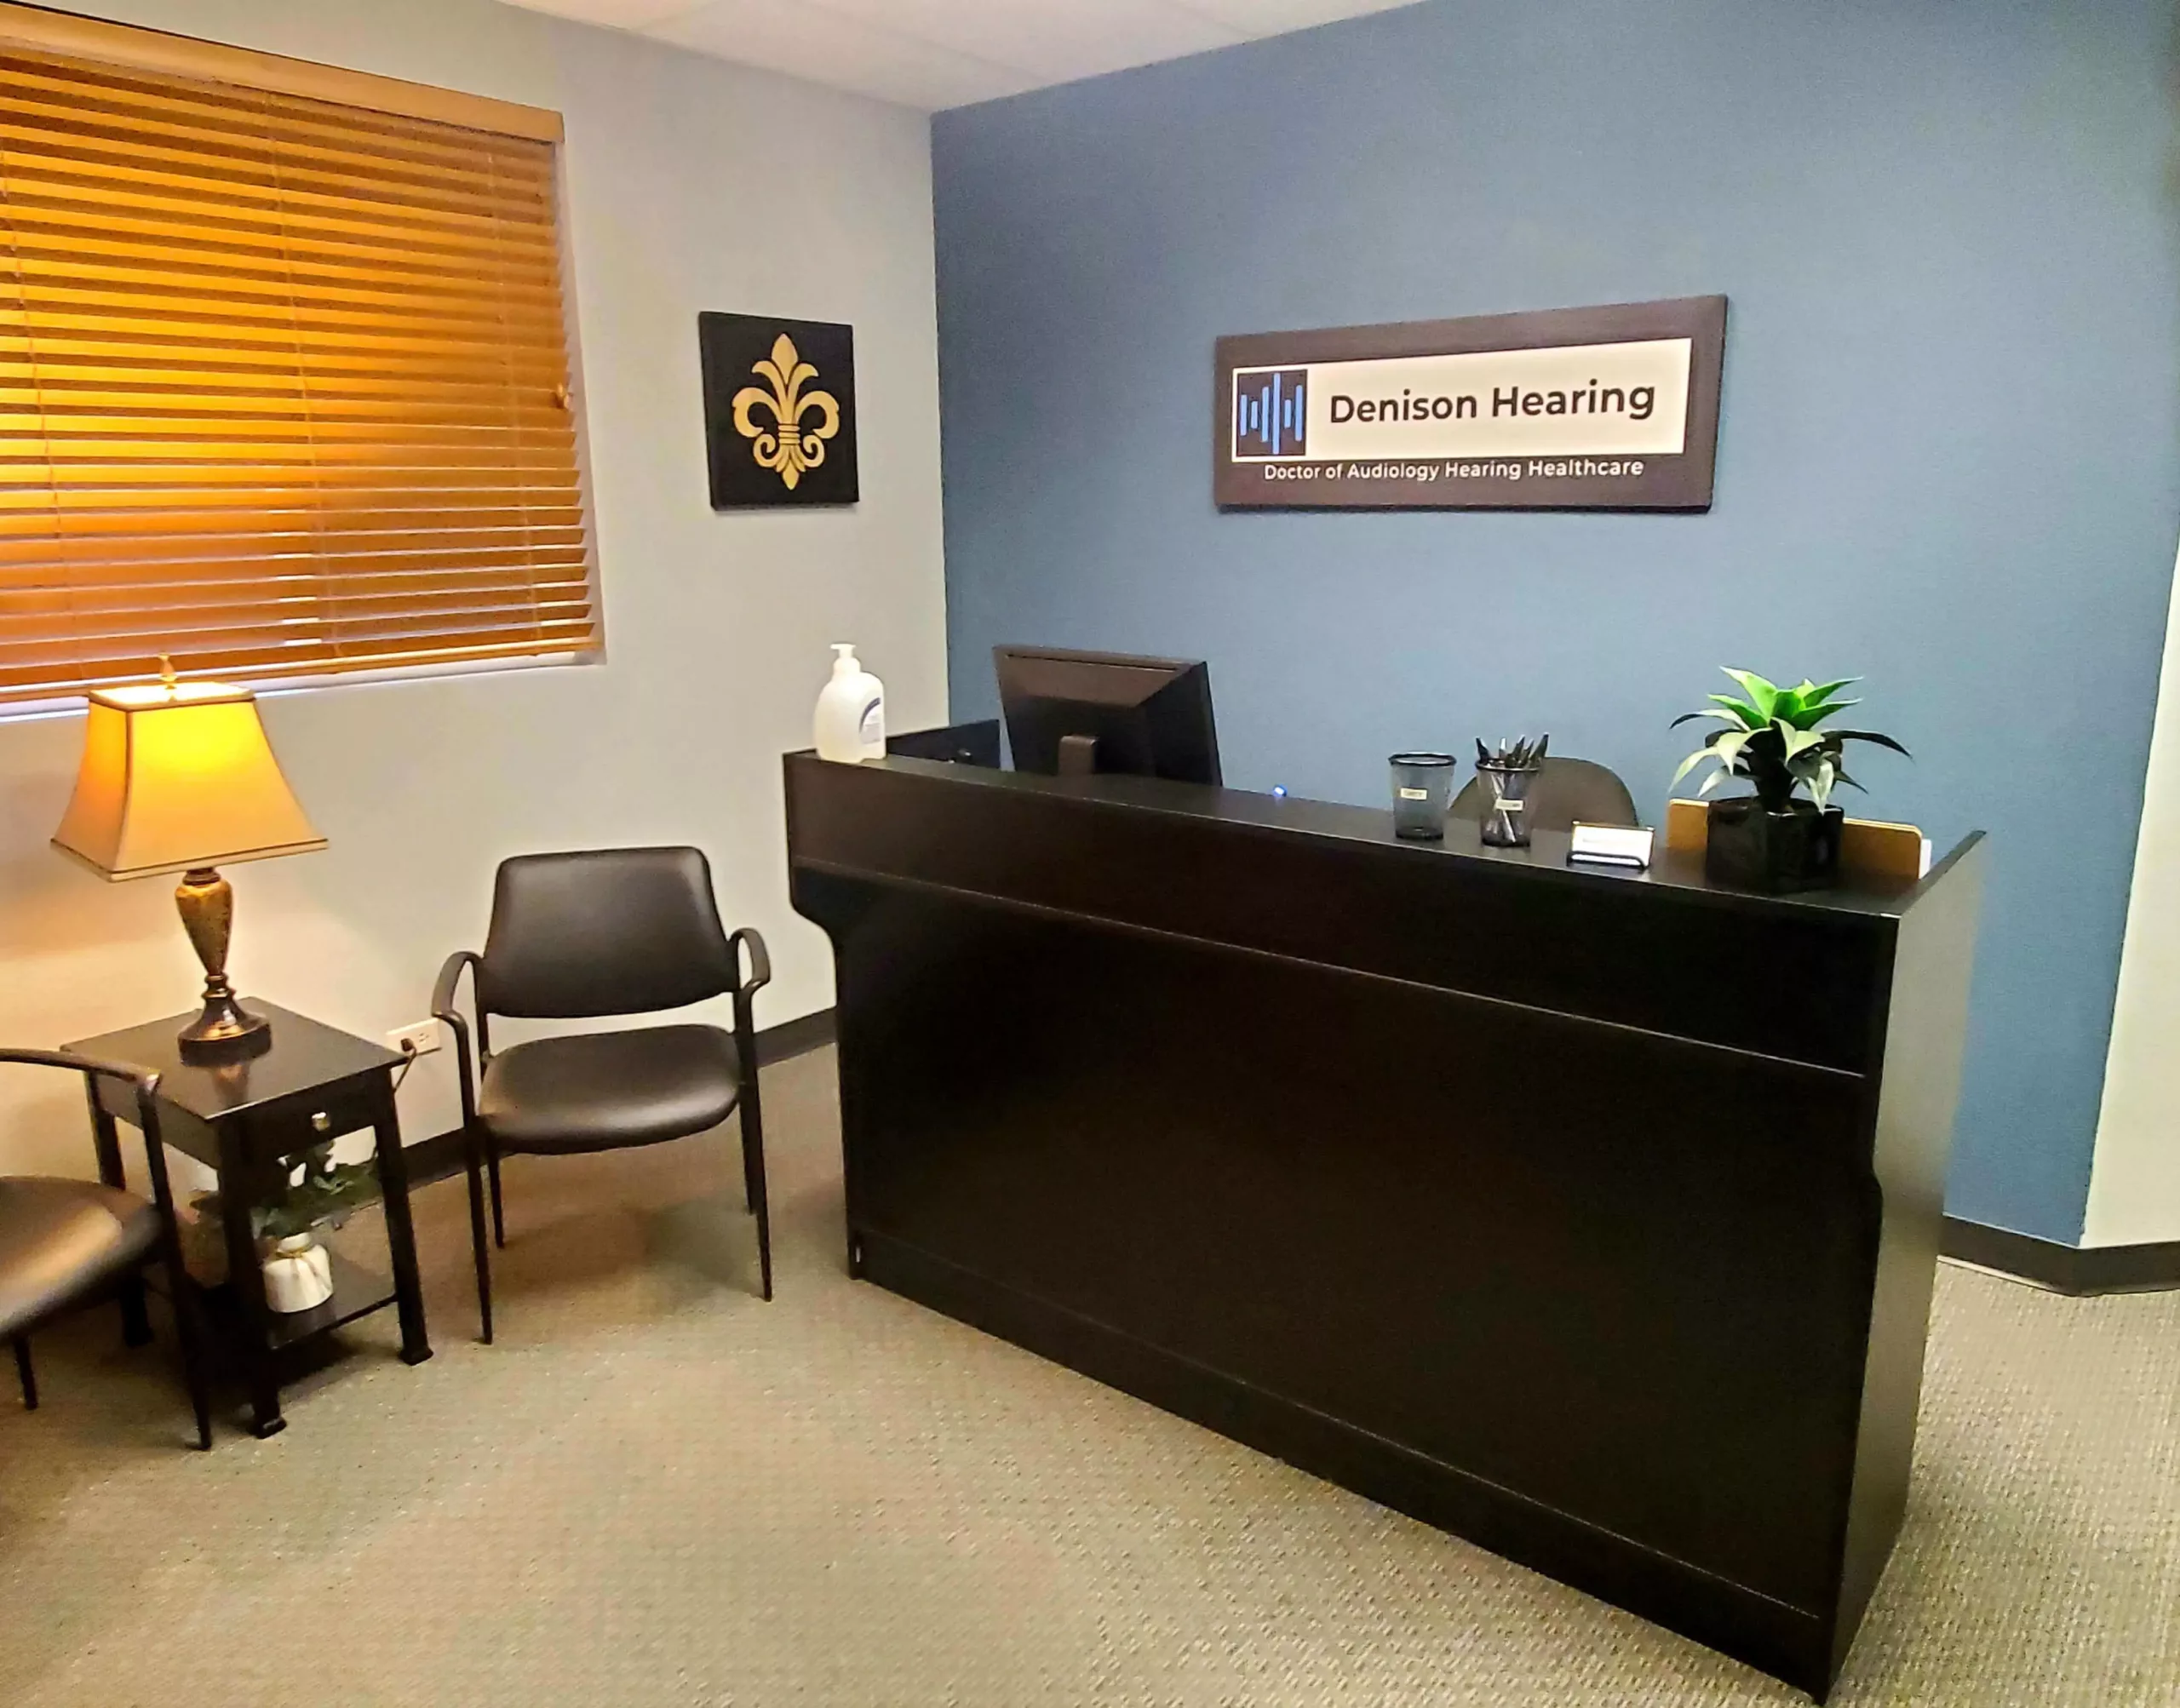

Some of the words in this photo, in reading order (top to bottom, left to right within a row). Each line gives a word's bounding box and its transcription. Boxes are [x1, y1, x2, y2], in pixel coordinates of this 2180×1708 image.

[1330, 388, 1477, 423] Denison
[1492, 378, 1655, 420] Hearing
[1264, 464, 1321, 480] Doctor
[1325, 463, 1343, 479] of
[1347, 462, 1440, 482] Audiology
[1445, 460, 1522, 481] Hearing
[1529, 458, 1645, 477] Healthcare
